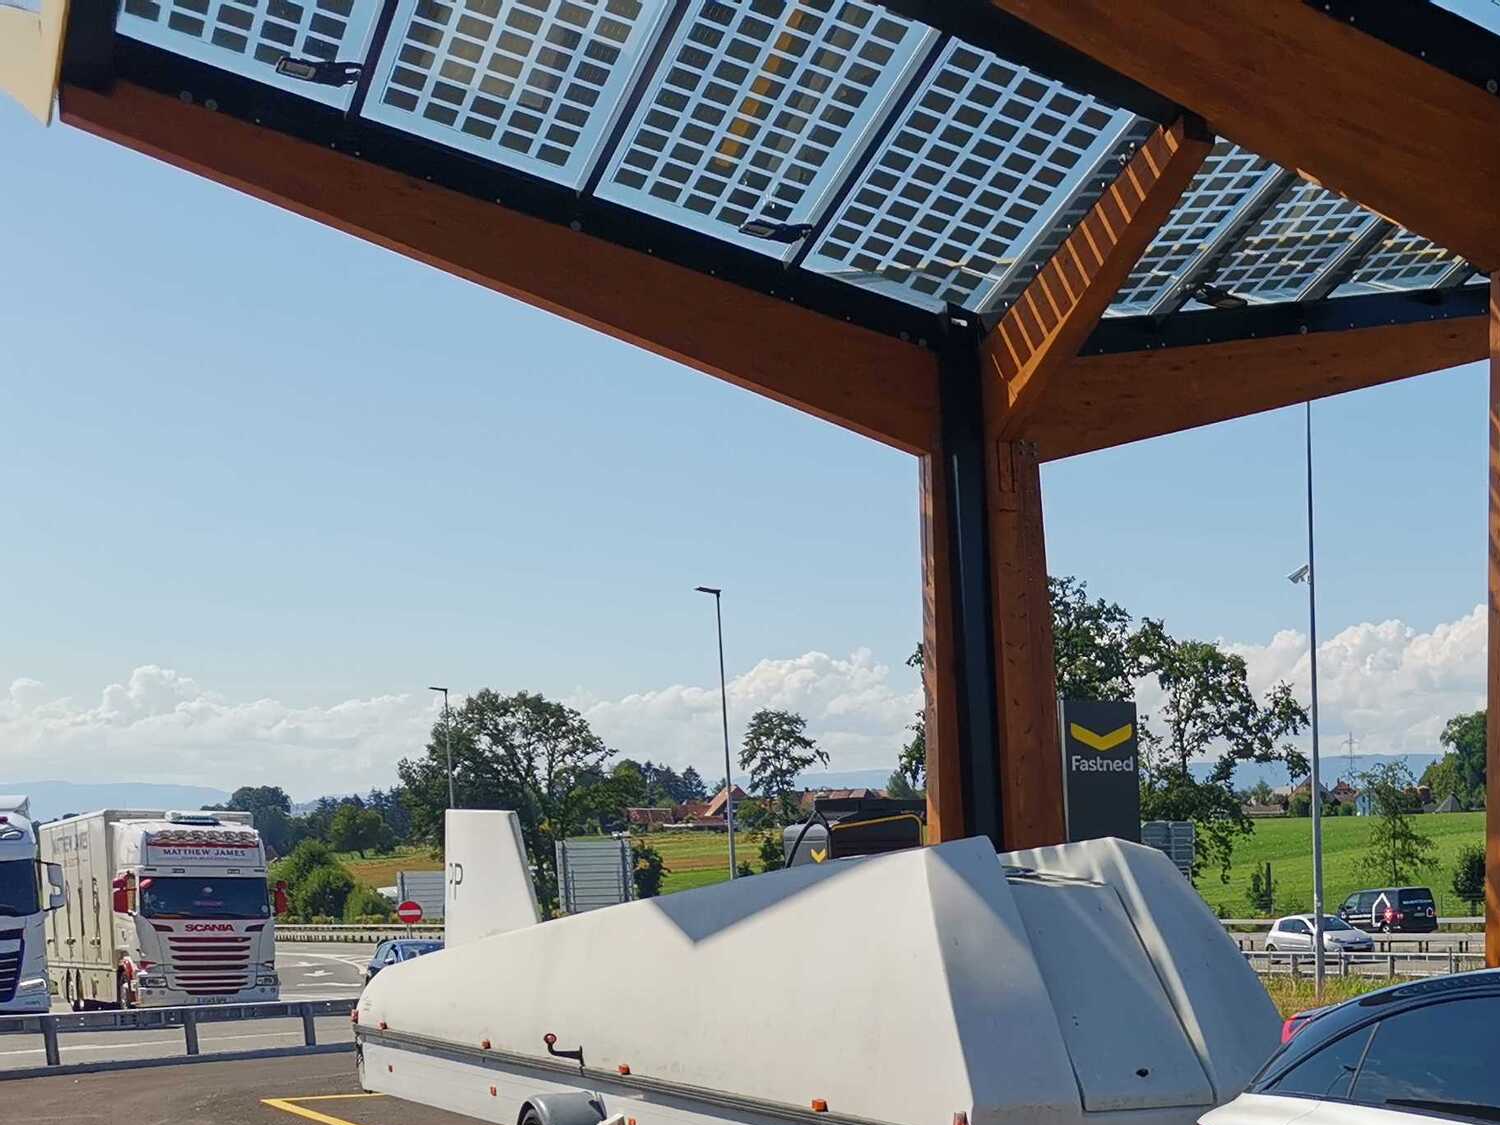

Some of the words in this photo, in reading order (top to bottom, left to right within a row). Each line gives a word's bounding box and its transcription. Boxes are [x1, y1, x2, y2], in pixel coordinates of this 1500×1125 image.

[1071, 755, 1134, 772] Fastned
[163, 848, 210, 856] MATTHEW
[214, 849, 246, 857] JAMES
[184, 923, 235, 932] SCANIA
